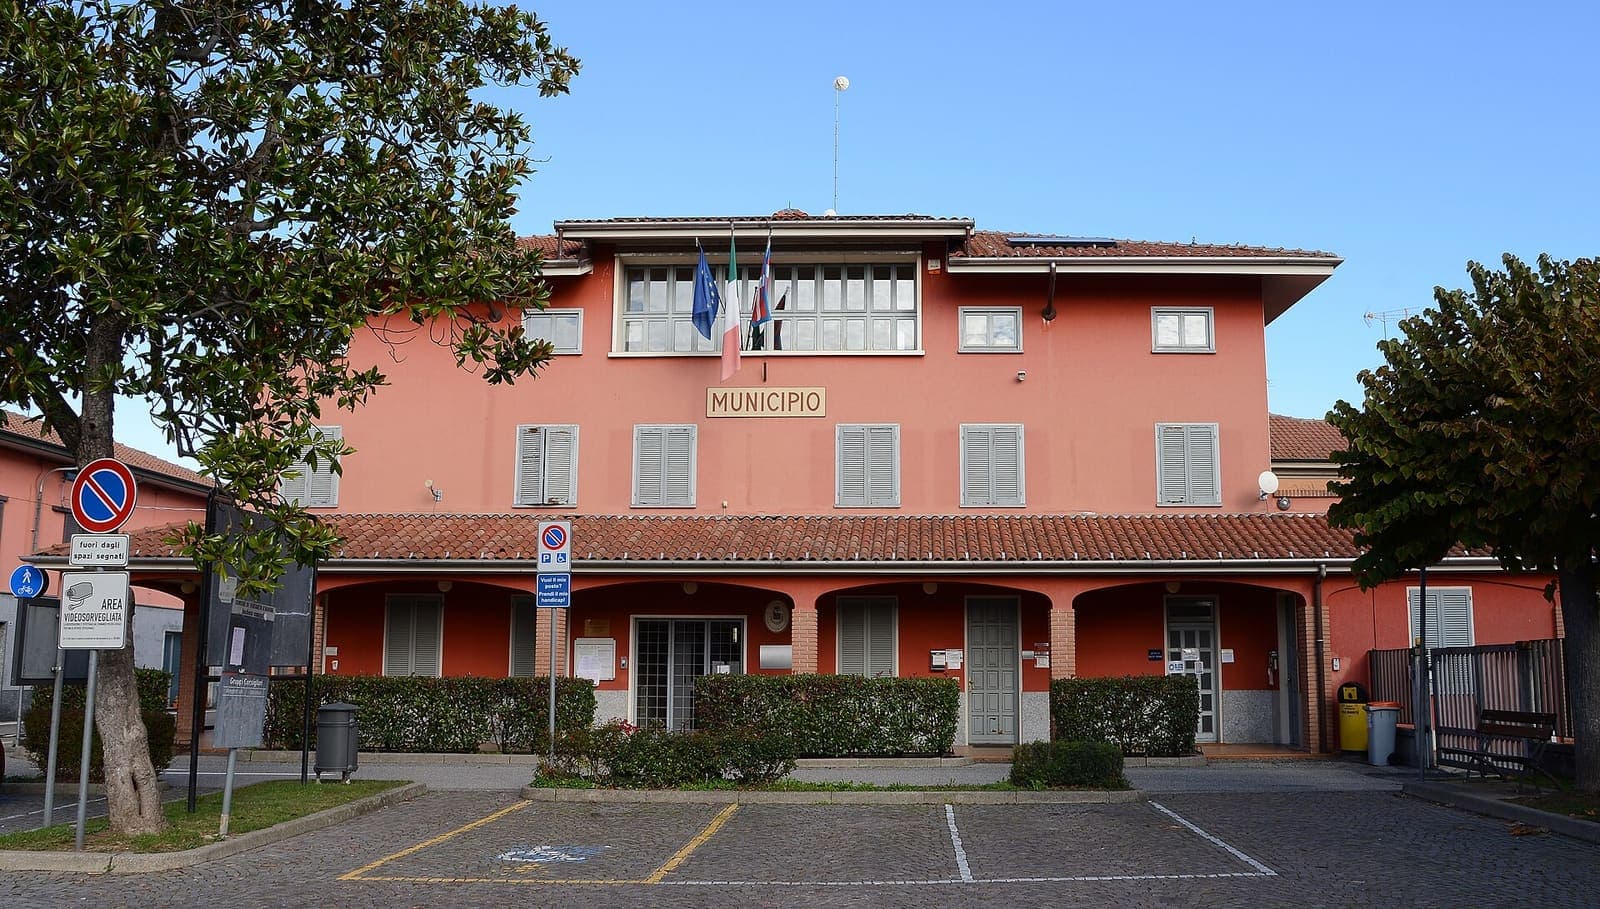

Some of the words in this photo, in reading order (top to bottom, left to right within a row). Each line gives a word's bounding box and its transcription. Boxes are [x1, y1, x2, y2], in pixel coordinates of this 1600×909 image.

[712, 391, 820, 412] MUNICIPIO
[80, 541, 98, 549] fuori
[101, 541, 120, 549] dagli
[74, 552, 93, 560] spazi
[96, 552, 125, 560] segnati
[101, 598, 123, 610] AREA
[64, 612, 122, 622] VIDEOSORVEGLIATA
